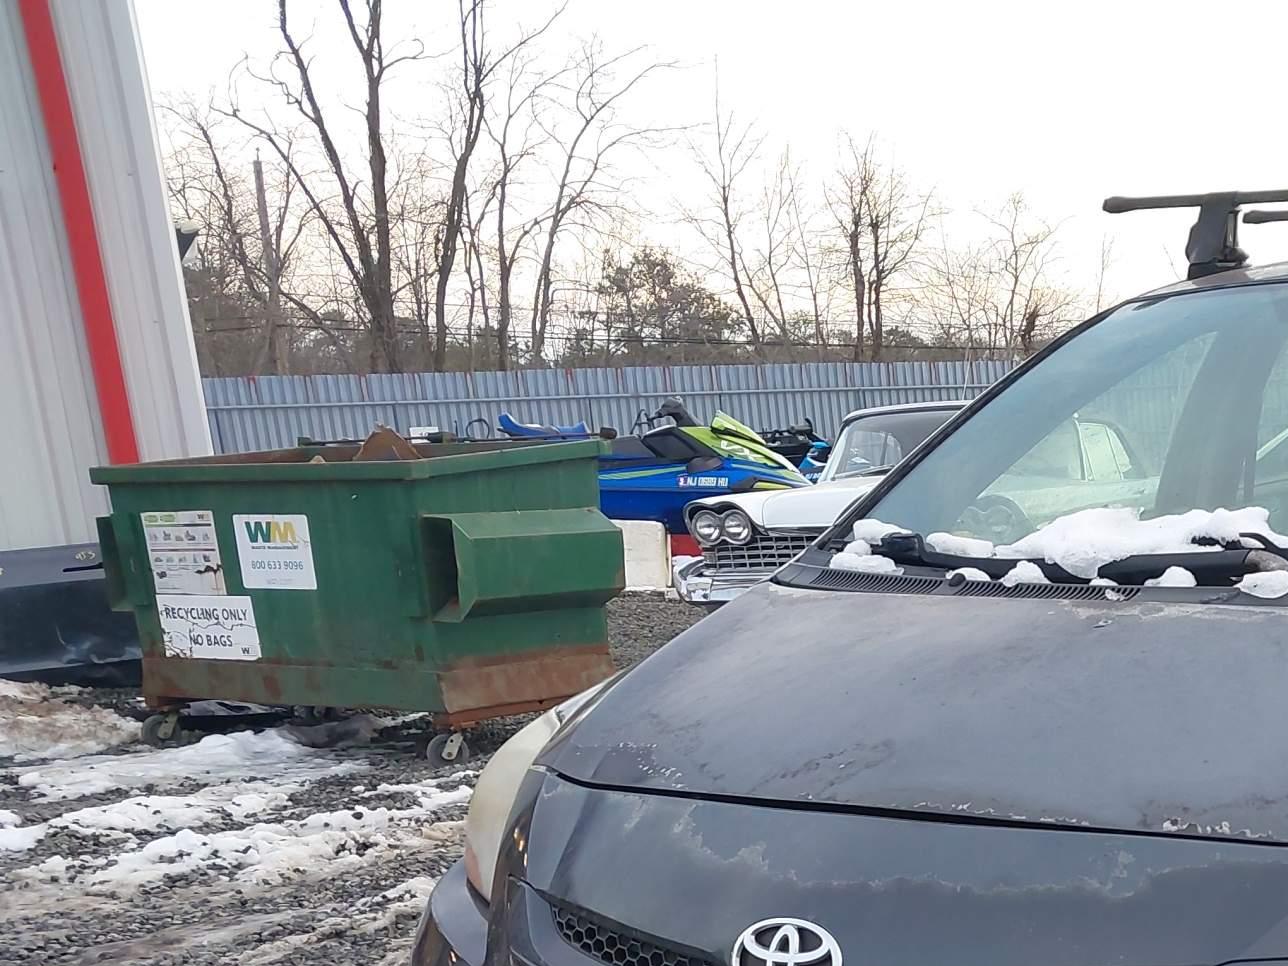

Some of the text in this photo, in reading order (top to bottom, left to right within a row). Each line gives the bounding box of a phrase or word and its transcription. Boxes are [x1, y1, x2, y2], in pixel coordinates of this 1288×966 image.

[244, 521, 297, 543] WM
[251, 560, 304, 570] 800 633 9096
[165, 607, 248, 621] RECYCLING ONLY
[190, 634, 233, 647] NO BAGS
